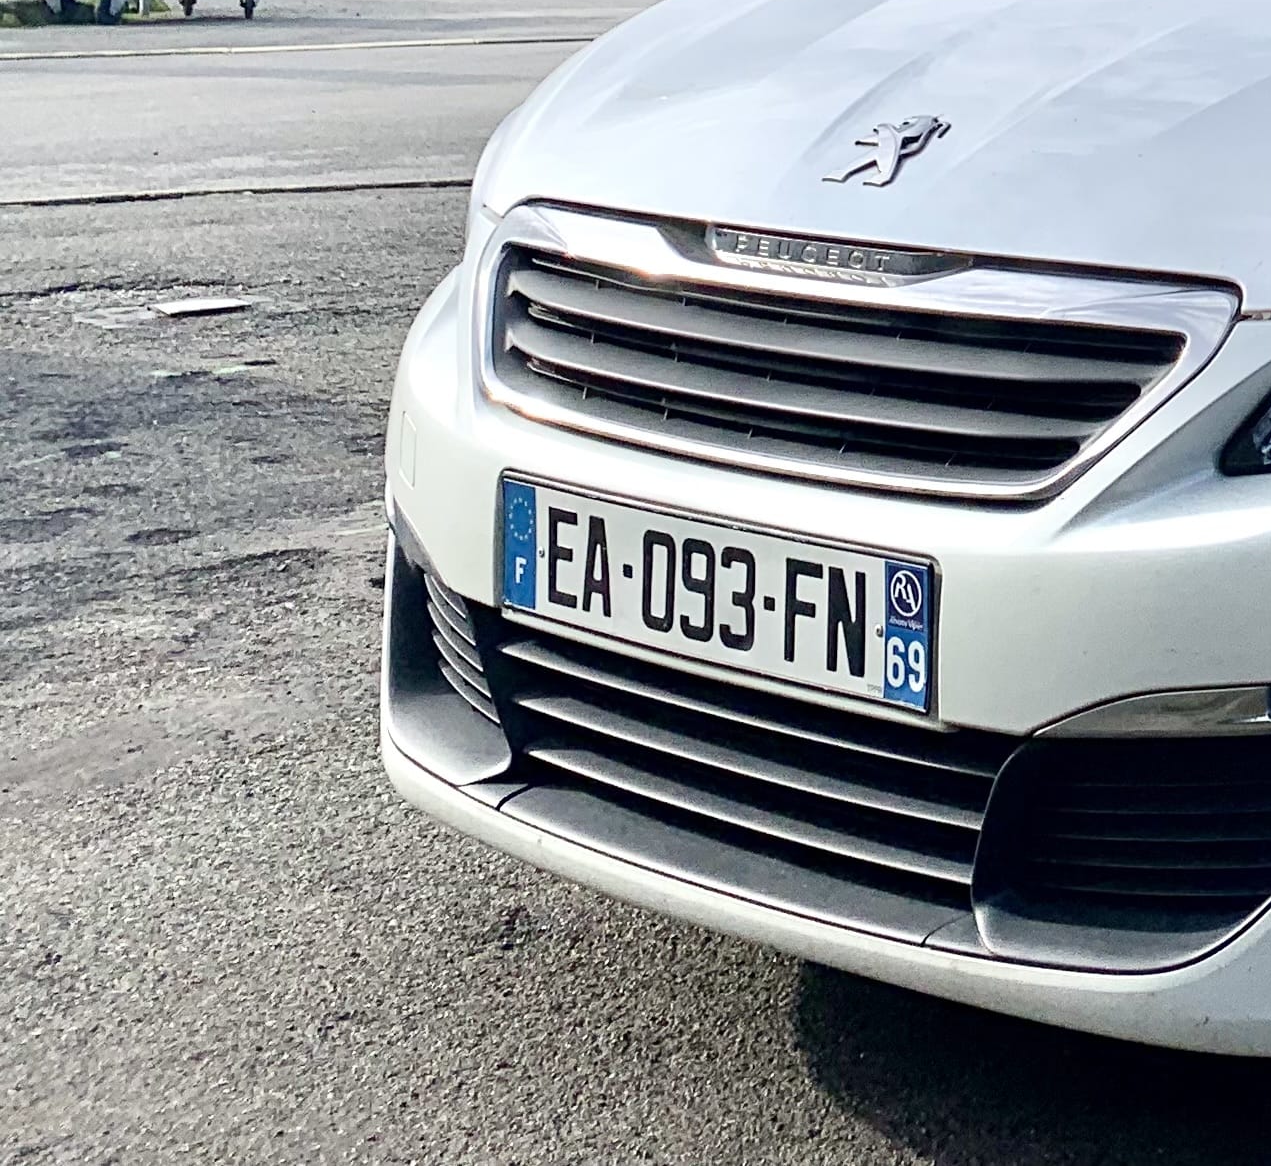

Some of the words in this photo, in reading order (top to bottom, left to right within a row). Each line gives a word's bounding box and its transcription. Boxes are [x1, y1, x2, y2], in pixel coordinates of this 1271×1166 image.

[734, 234, 890, 272] PEUGEOT
[514, 556, 527, 584] F
[886, 636, 926, 693] 69
